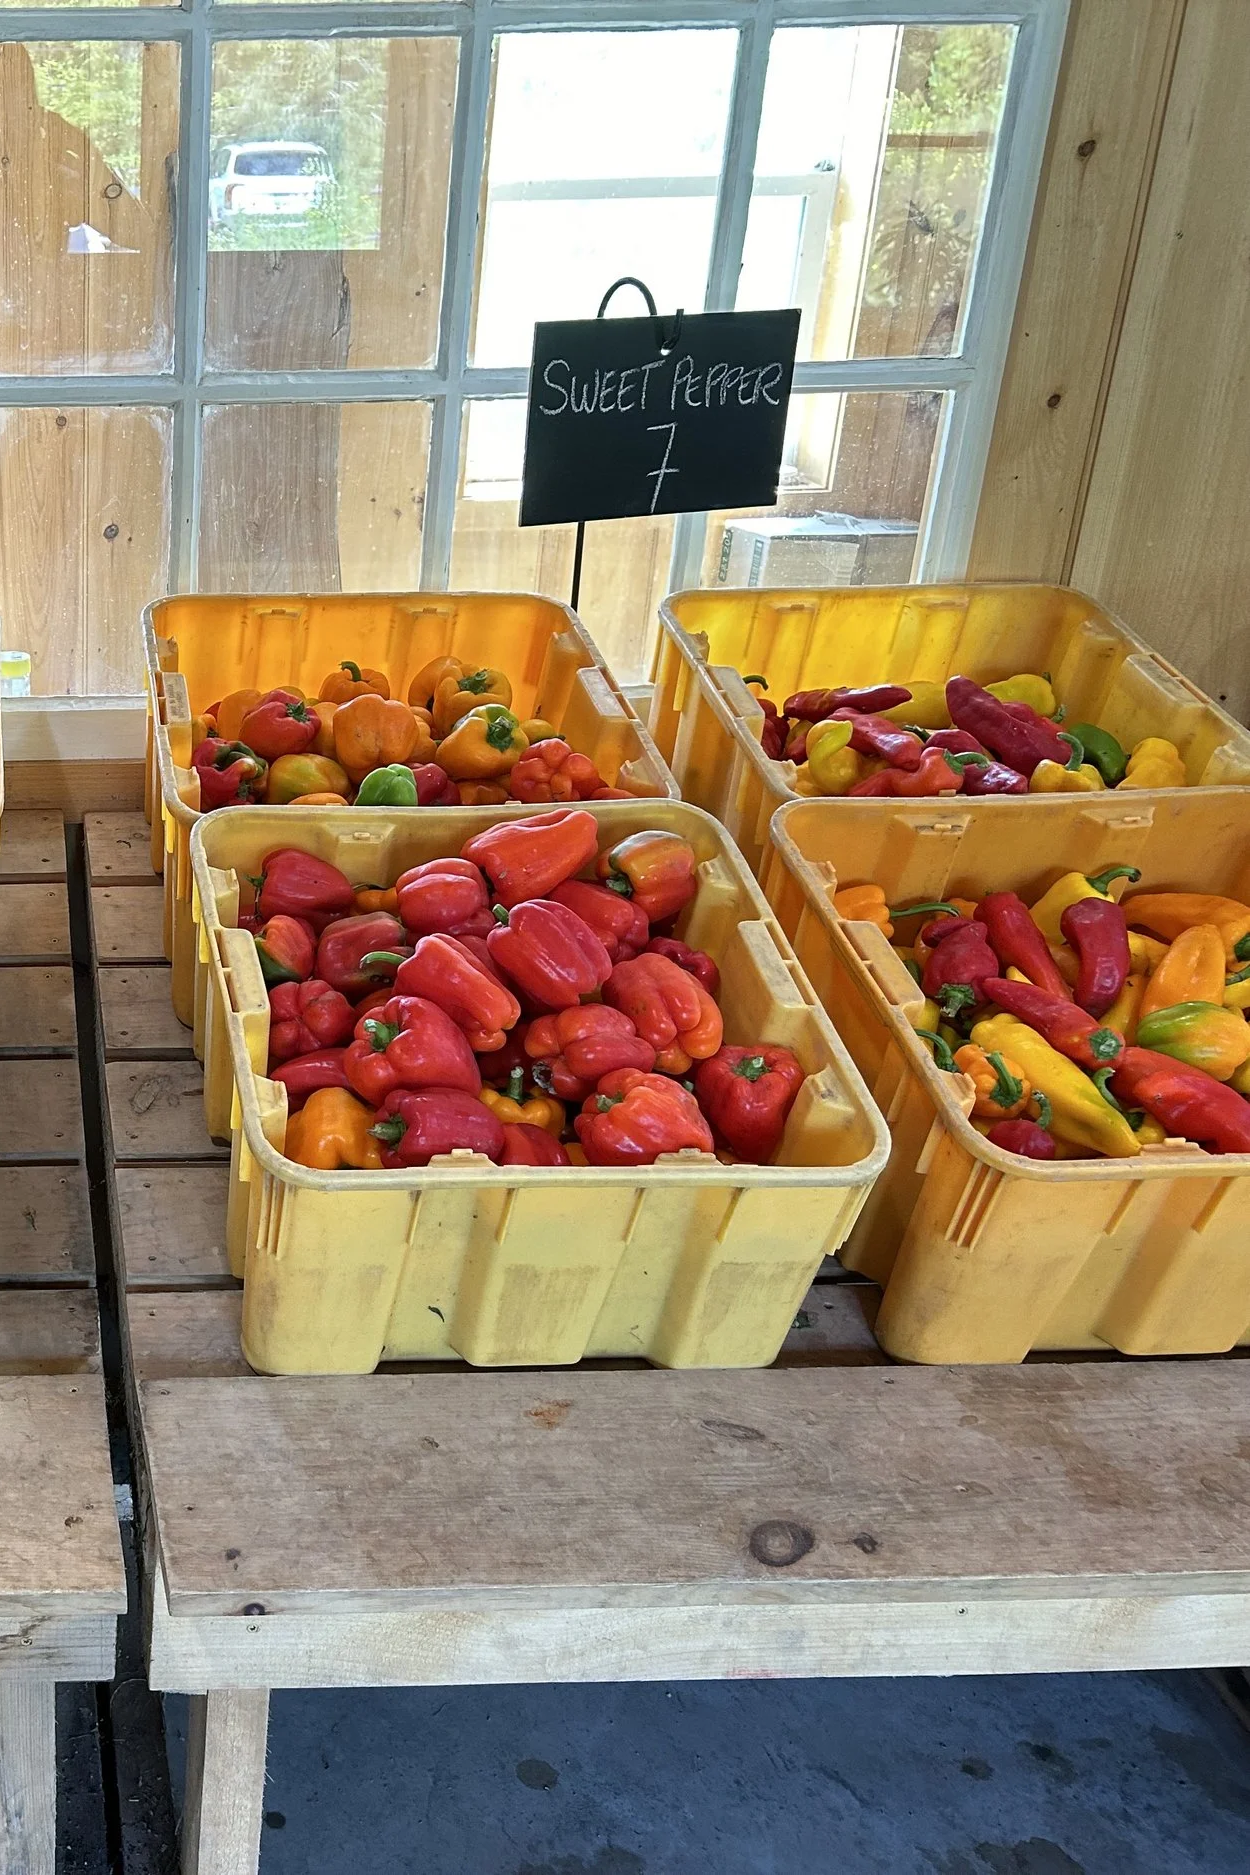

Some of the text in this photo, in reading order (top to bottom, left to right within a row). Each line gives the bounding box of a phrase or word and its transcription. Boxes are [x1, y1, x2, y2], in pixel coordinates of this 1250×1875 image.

[539, 354, 784, 416] SWEET PEPPER
[645, 421, 680, 514] 7
